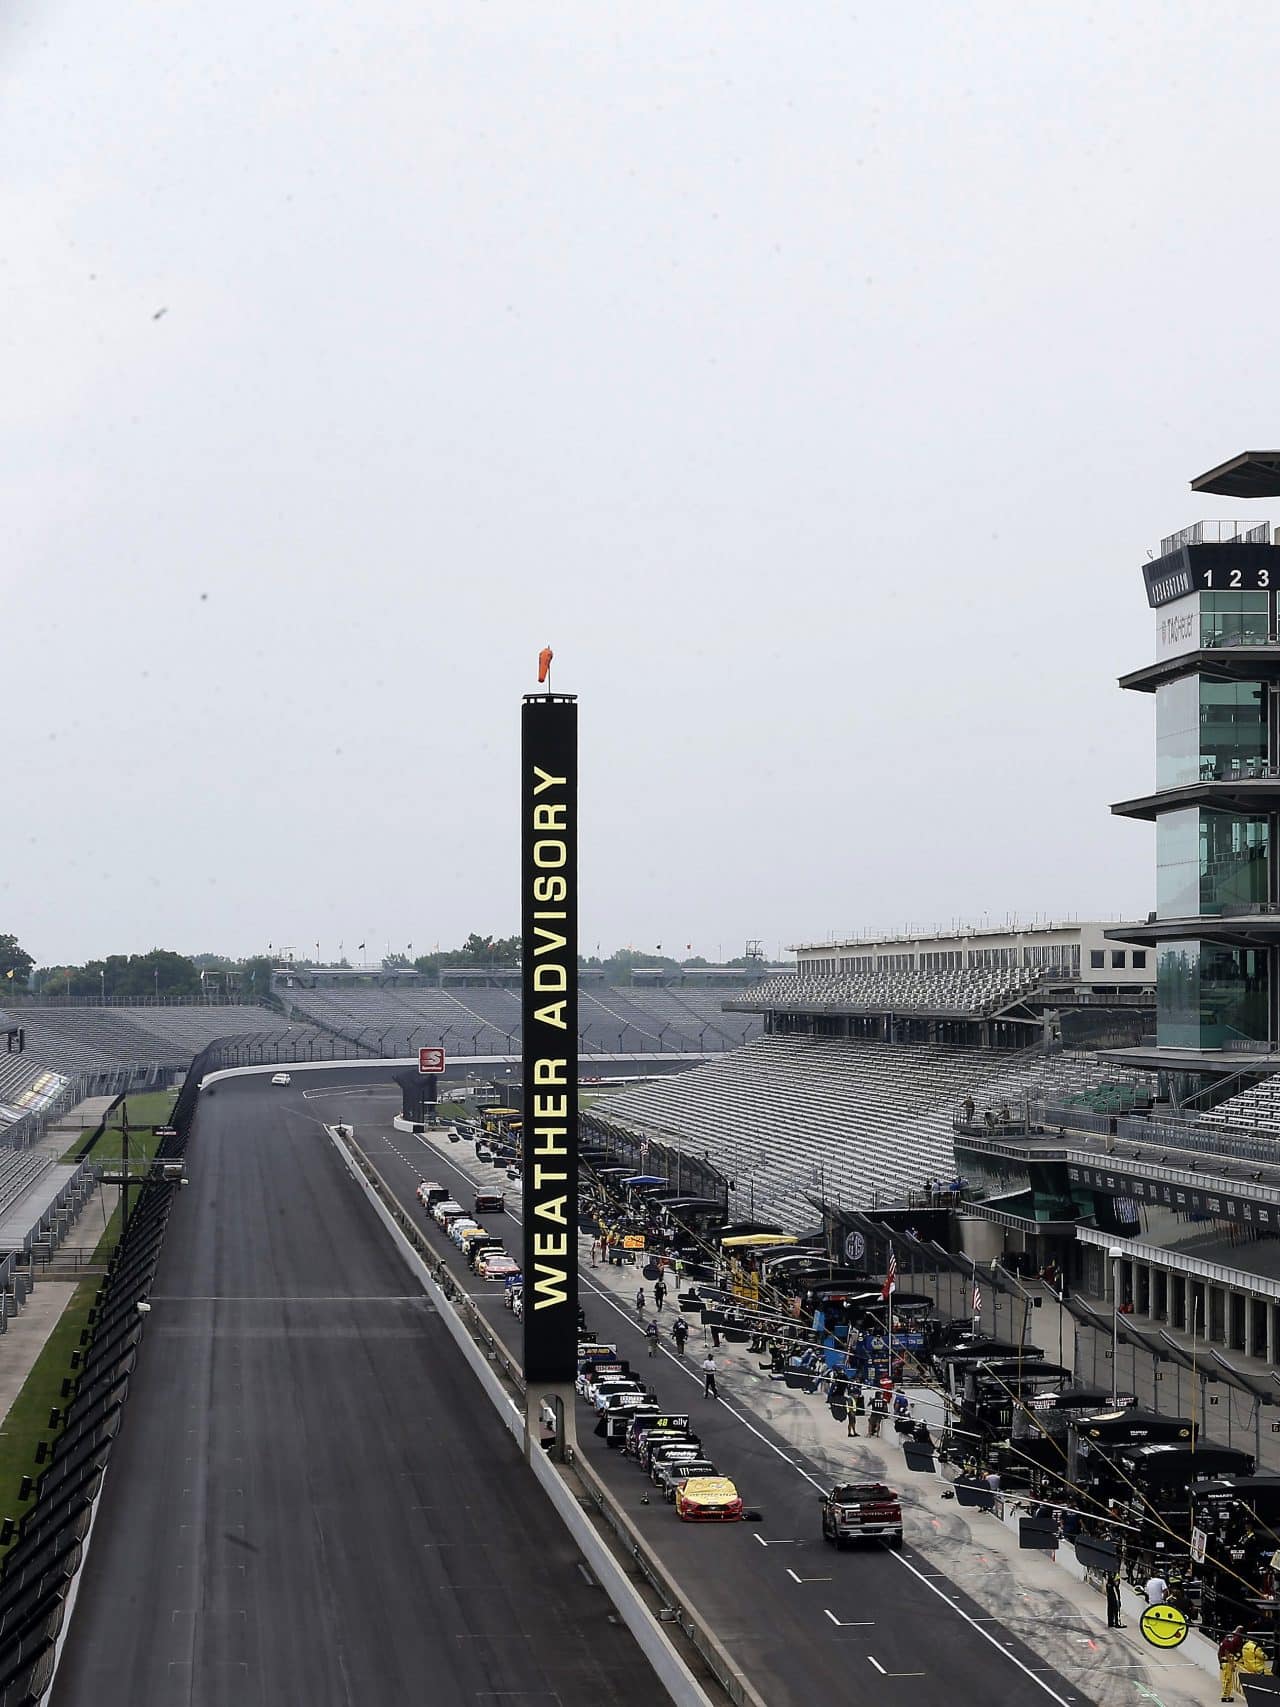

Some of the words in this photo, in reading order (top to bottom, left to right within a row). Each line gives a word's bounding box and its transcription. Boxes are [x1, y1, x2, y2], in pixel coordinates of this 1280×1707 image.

[1203, 569, 1213, 587] 1
[1229, 569, 1242, 587] 2
[1257, 569, 1270, 587] 3
[534, 765, 567, 1030] ADVISORY
[534, 1058, 567, 1311] WEATHER
[673, 1418, 688, 1428] ally
